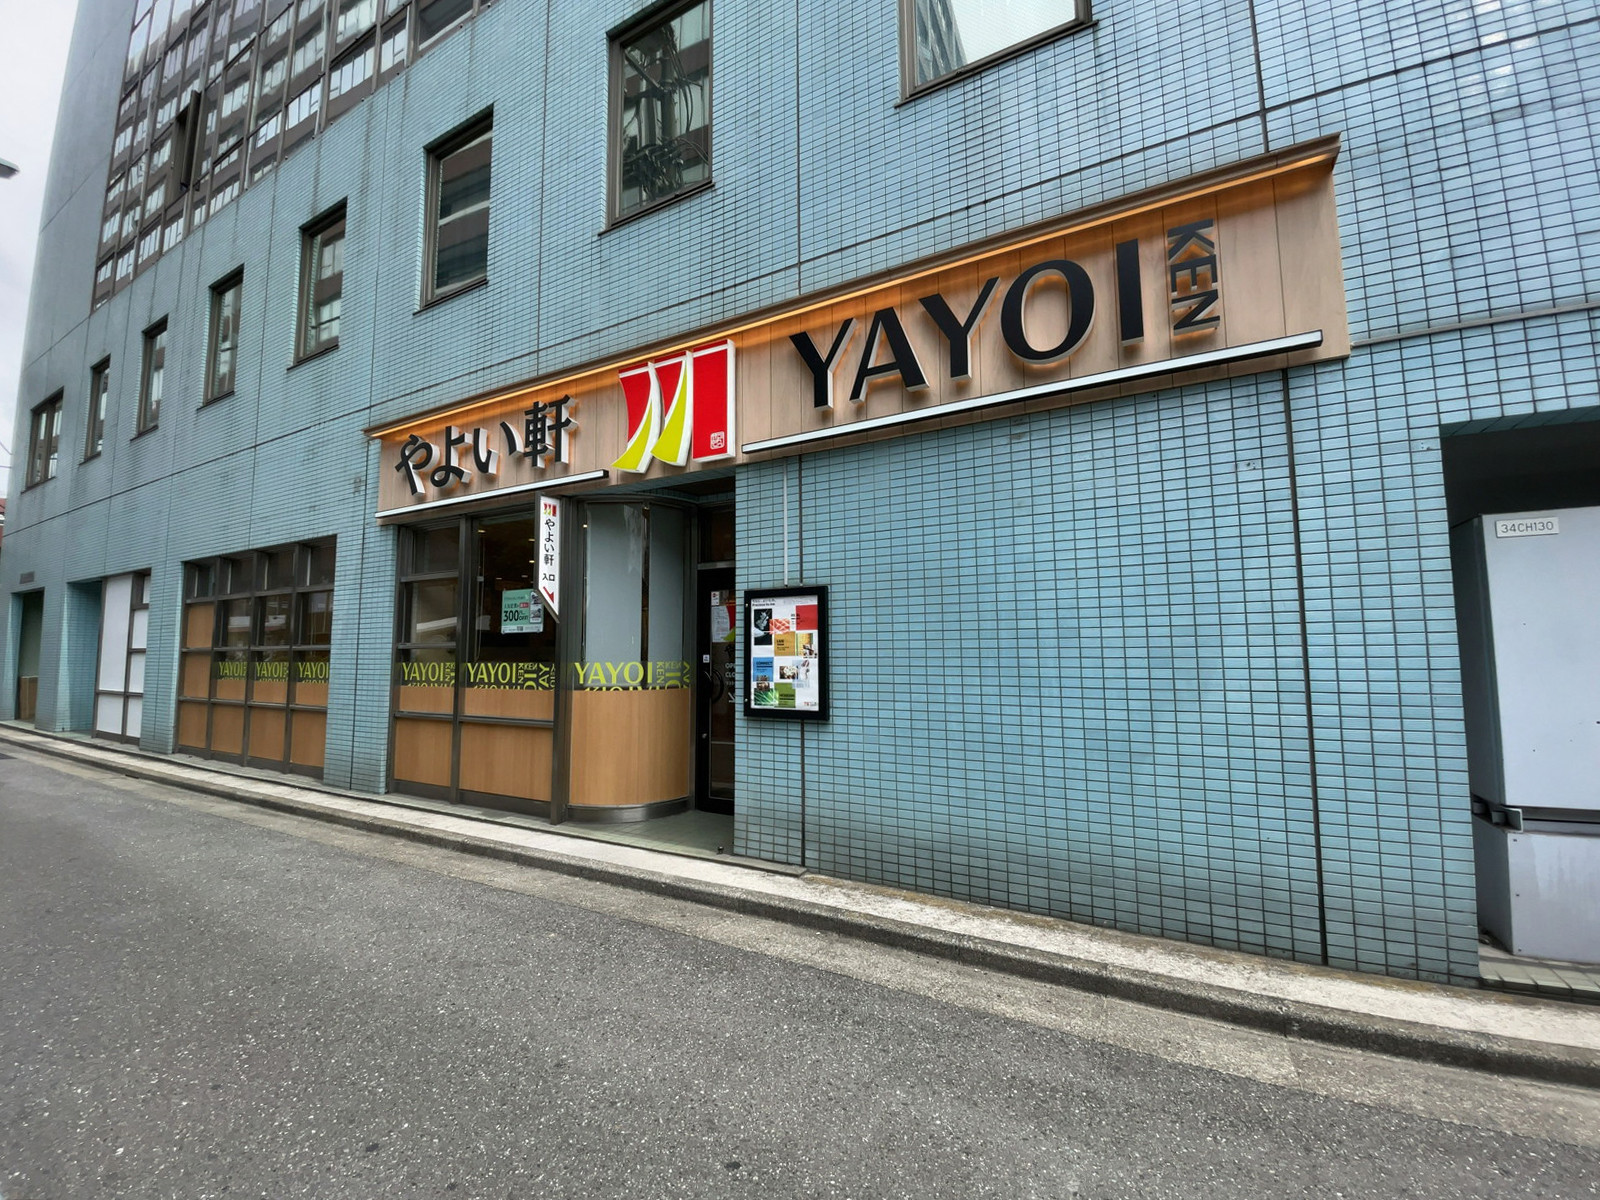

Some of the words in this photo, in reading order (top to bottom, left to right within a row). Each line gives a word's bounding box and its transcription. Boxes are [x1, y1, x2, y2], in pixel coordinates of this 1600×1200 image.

[1167, 218, 1221, 336] KEN
[789, 238, 1144, 410] YAYOI
[395, 394, 576, 496] やよい軒
[1500, 520, 1555, 534] 34CH130
[543, 518, 556, 566] やよい軒
[542, 572, 555, 581] 入口
[219, 661, 242, 676] YAYOI
[256, 661, 283, 678] YAYOI
[298, 662, 329, 679] YAYOI
[402, 662, 444, 682] YAYOI
[467, 662, 516, 684] YAYOI
[574, 661, 653, 685] YAYOI
[656, 661, 665, 684] KEN
